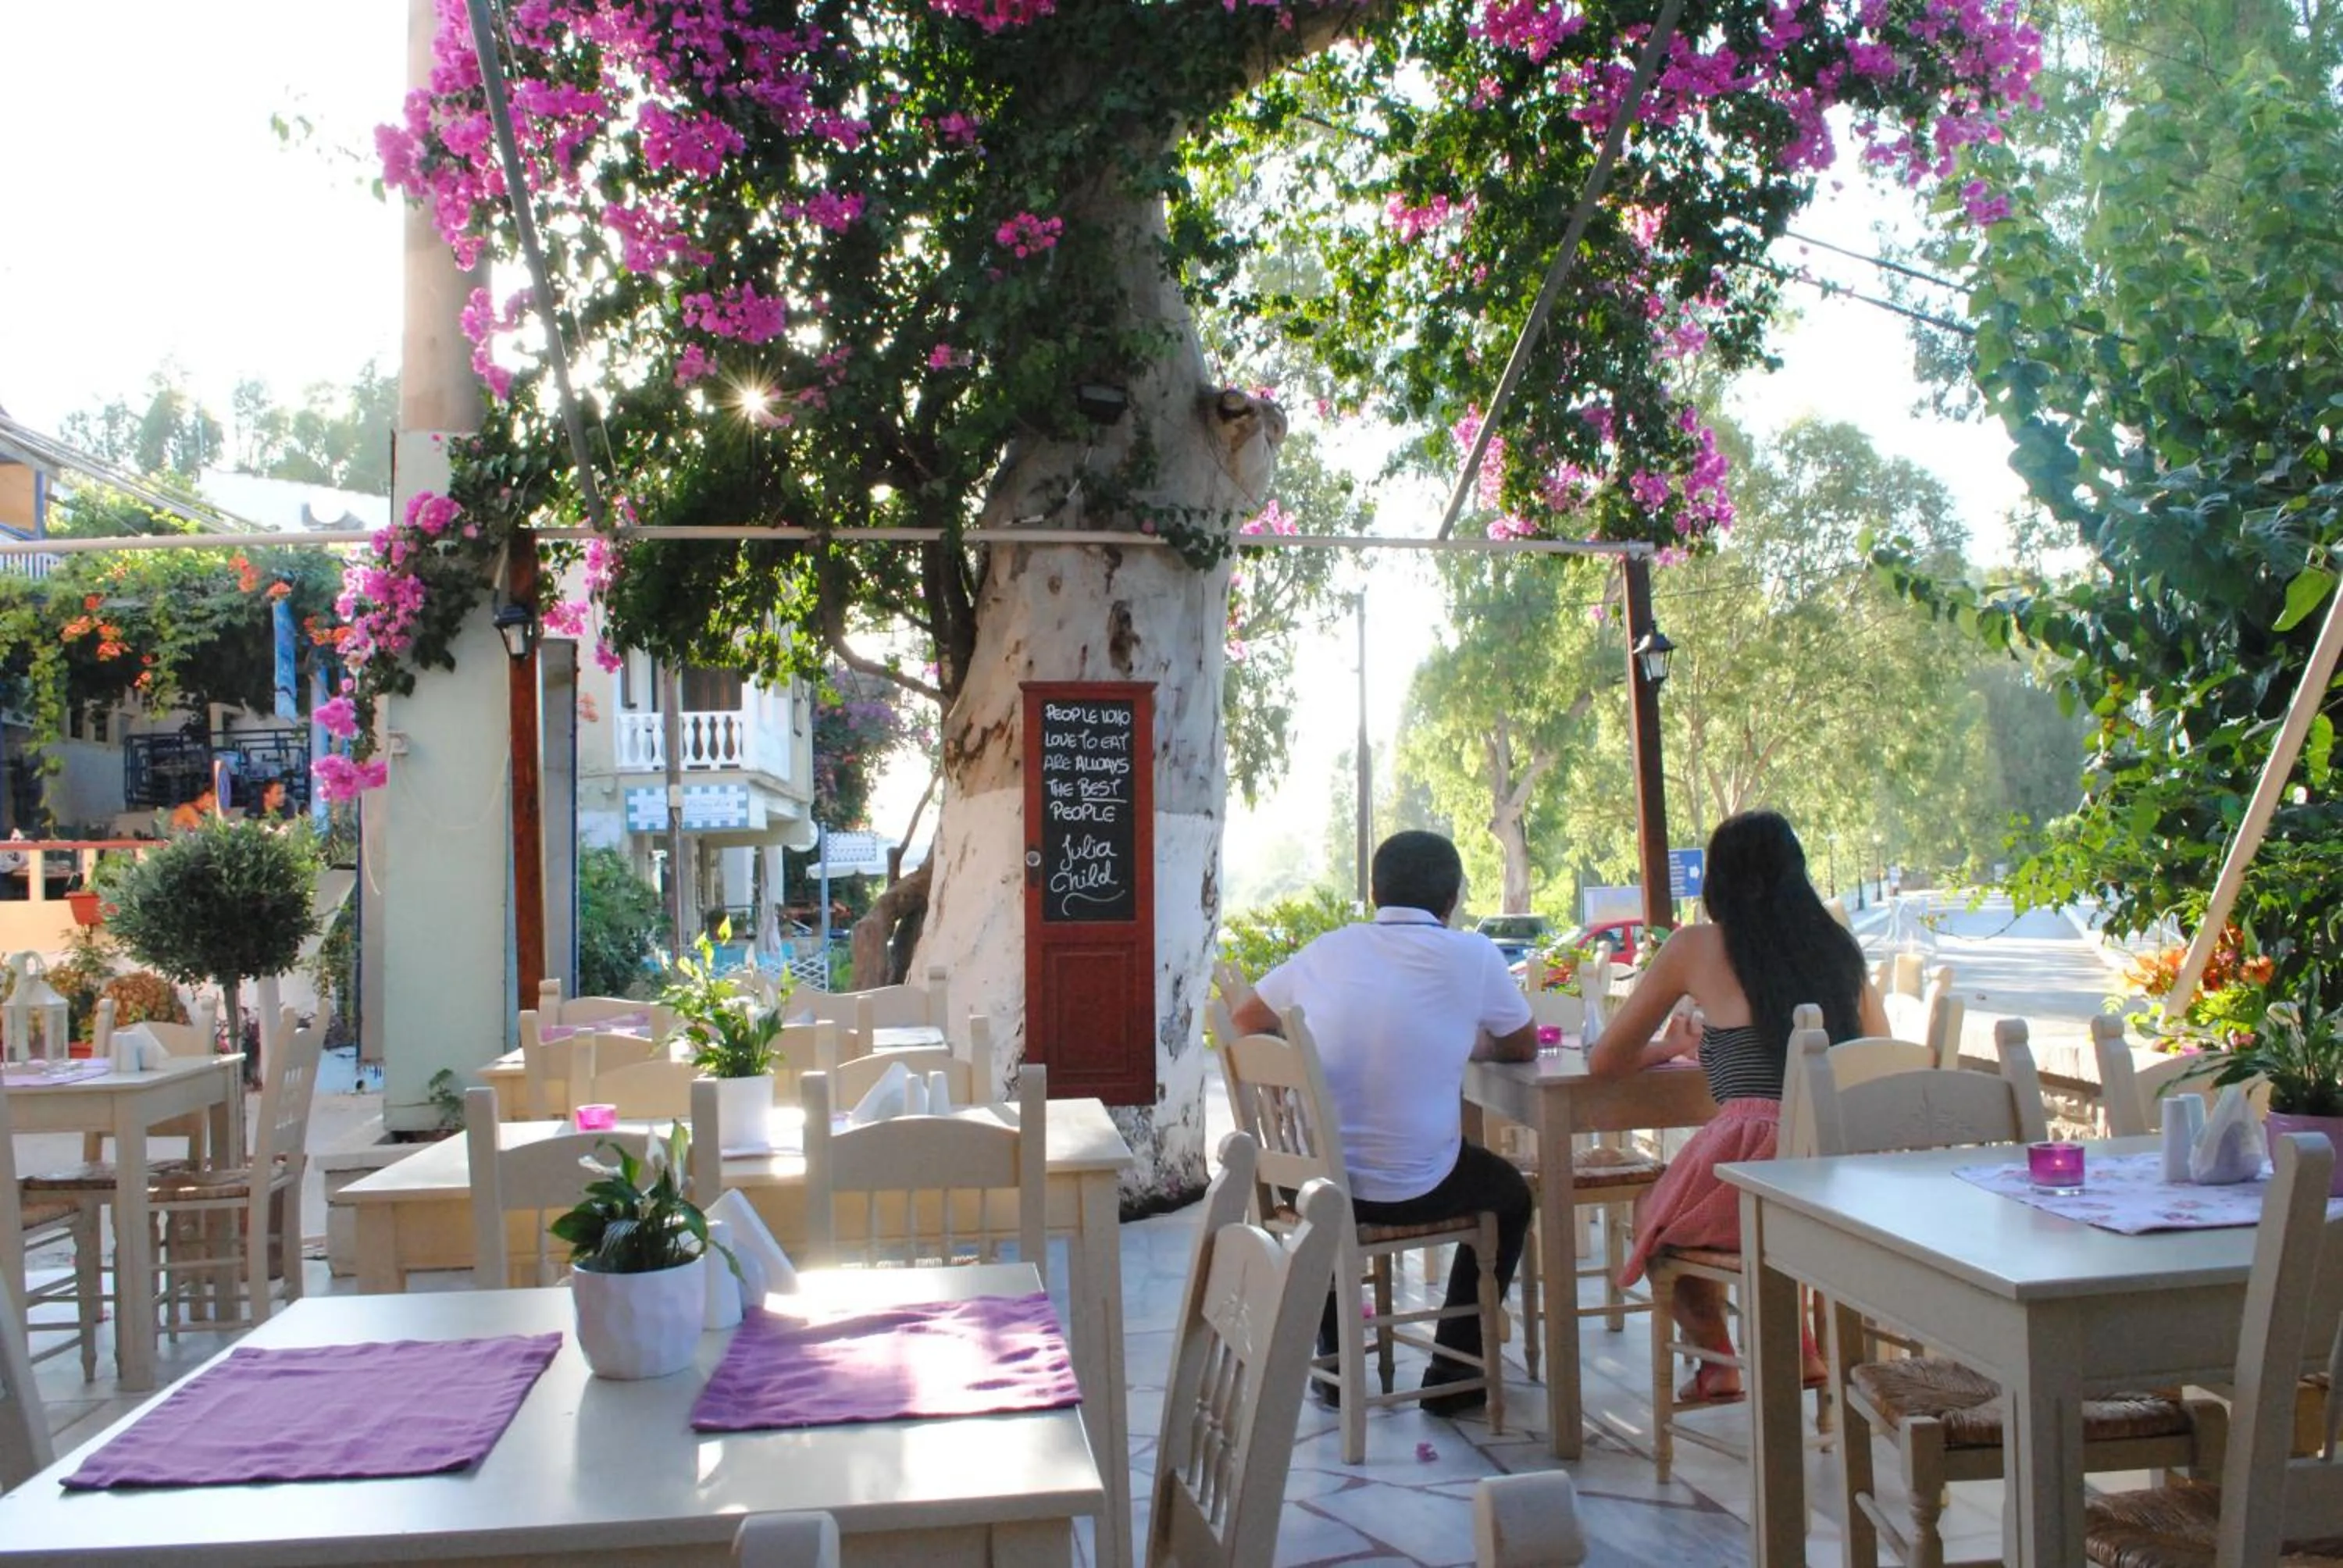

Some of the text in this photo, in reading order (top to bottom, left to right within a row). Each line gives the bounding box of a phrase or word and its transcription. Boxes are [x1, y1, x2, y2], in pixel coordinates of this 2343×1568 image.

[1046, 704, 1098, 725] PEOPLE
[1046, 729, 1130, 750] LOVE TO EAT
[1043, 753, 1072, 771] ARE
[1046, 777, 1122, 797] THE BEST
[1050, 800, 1115, 822] PEOPLE
[1060, 833, 1118, 871] Julia
[1050, 860, 1118, 893] Child
